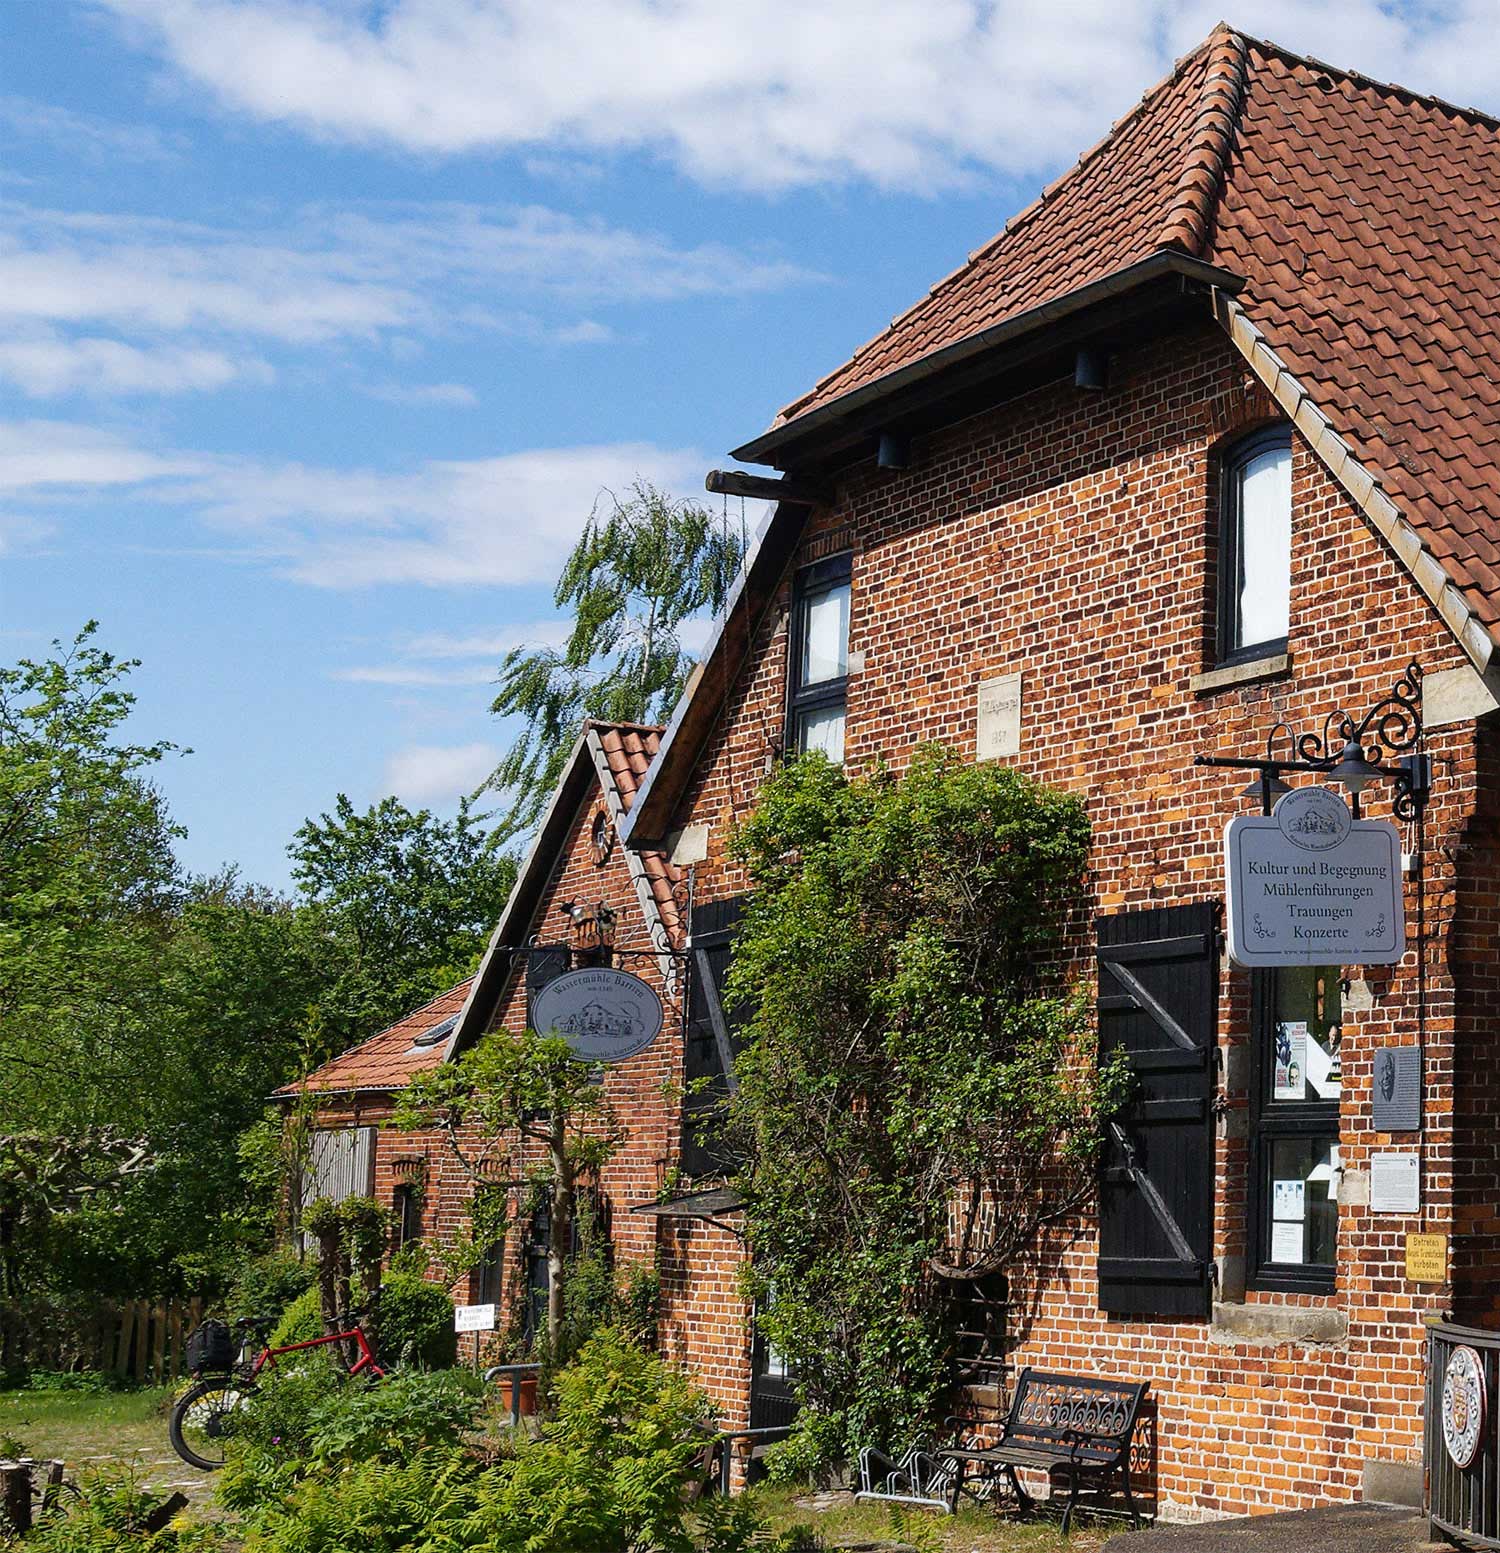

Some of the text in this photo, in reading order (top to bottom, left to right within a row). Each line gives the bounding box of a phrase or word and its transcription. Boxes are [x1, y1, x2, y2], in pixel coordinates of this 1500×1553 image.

[1248, 861, 1387, 879] Kultur und Begegnung
[1263, 882, 1374, 900] Mühlenführungen
[1286, 904, 1353, 921] Trauungen
[1293, 925, 1349, 939] Konzerte
[552, 973, 645, 999] Wassermühle Barrien
